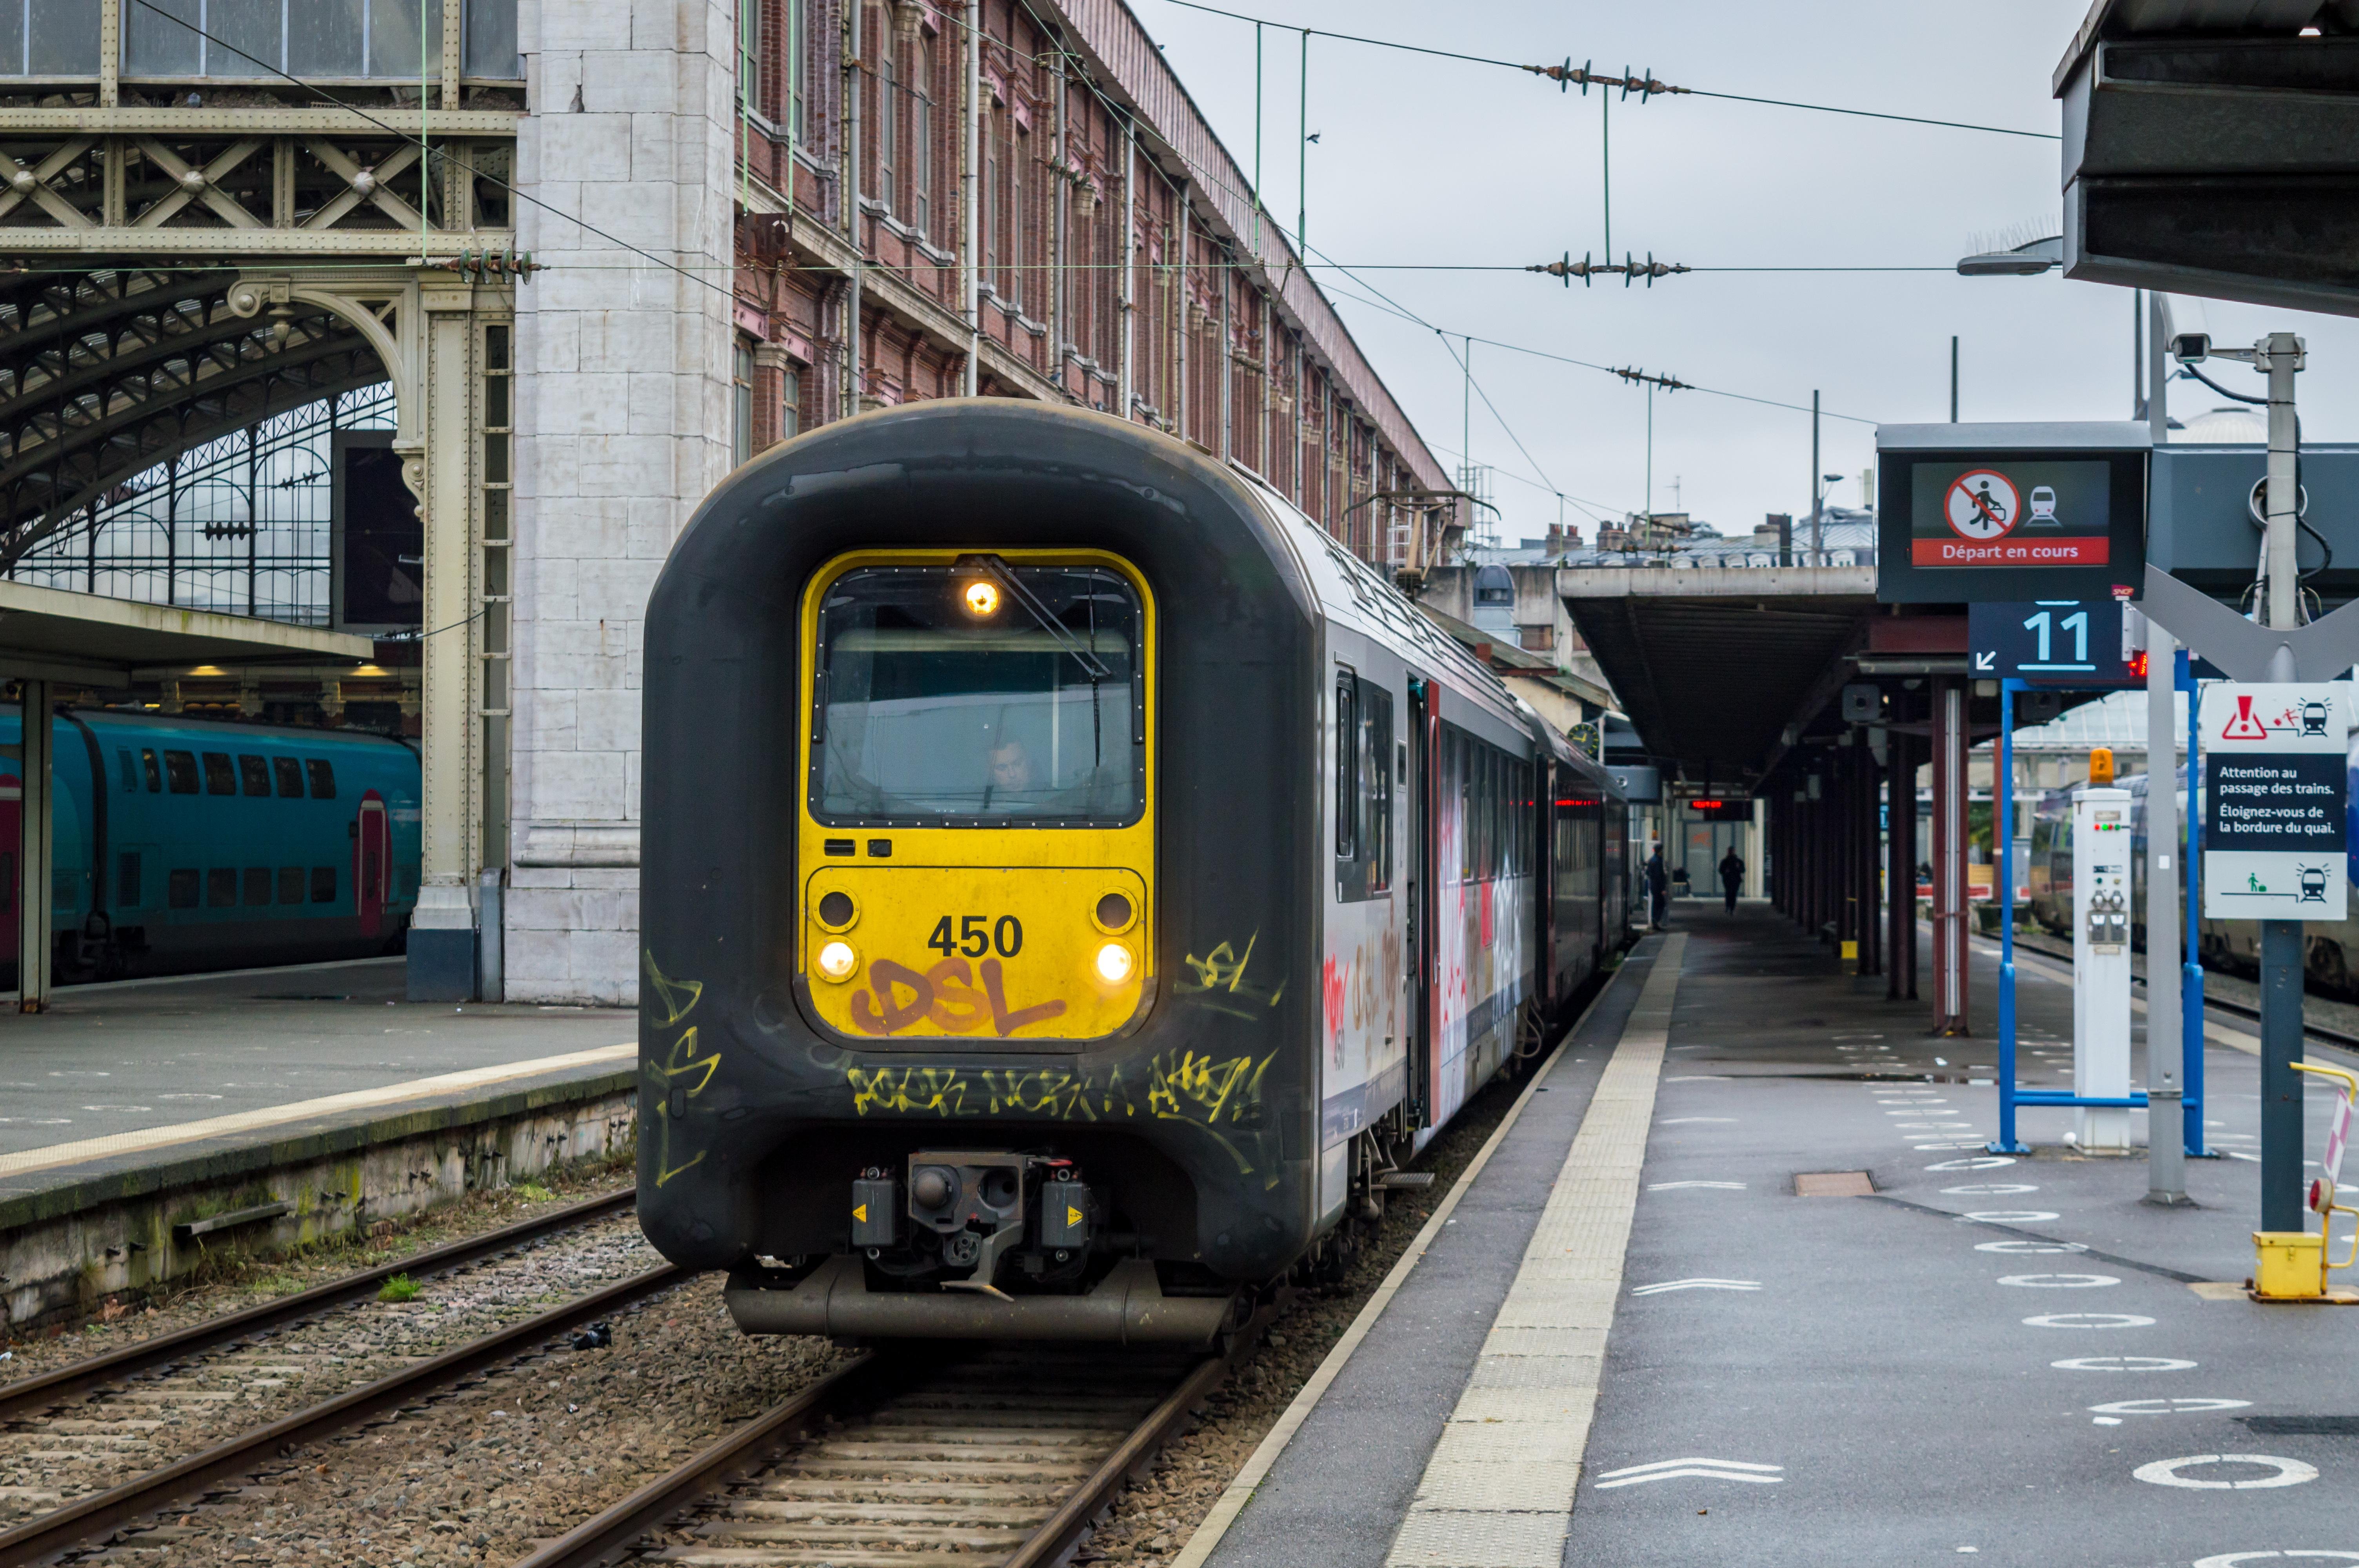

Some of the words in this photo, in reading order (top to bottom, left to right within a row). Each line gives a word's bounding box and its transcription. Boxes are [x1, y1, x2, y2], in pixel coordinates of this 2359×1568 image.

[1943, 545, 2001, 561] Départ
[2006, 547, 2026, 558] en
[2032, 547, 2078, 558] cours
[2023, 612, 2088, 661] 11
[2219, 766, 2279, 778] Attention
[2281, 769, 2297, 778] au
[2220, 784, 2268, 797] passage
[2271, 782, 2293, 794] des
[2295, 783, 2334, 795] trains.
[2220, 803, 2305, 820] Éloignez-vous
[2308, 806, 2324, 818] de
[2219, 821, 2230, 833] la
[2234, 821, 2283, 833] bordure
[2285, 822, 2301, 833] du
[2304, 822, 2335, 836] quai.
[928, 915, 1023, 958] 450
[1334, 1027, 1345, 1071] 450
